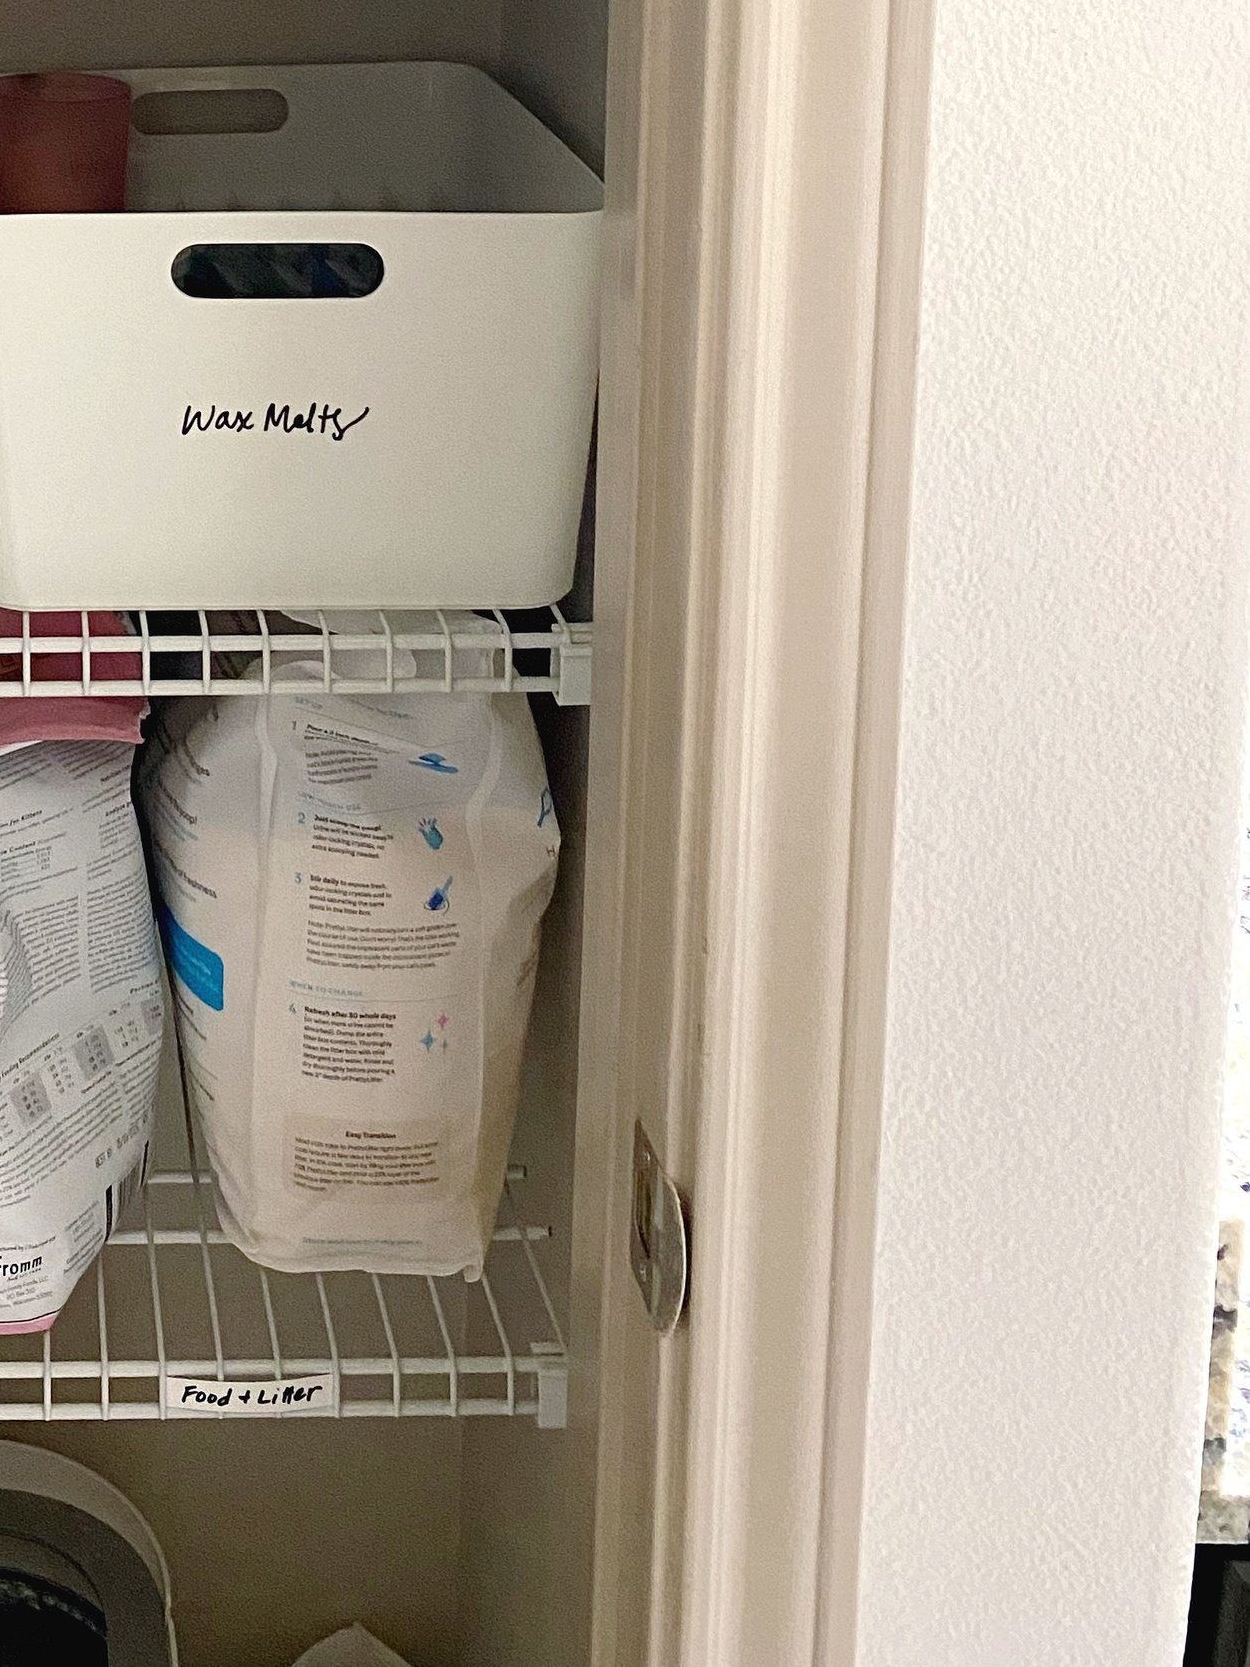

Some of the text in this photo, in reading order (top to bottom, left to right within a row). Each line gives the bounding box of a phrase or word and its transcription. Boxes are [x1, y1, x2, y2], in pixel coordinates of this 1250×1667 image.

[182, 402, 370, 441] Wax Melts
[181, 1385, 323, 1406] Food + Litter
